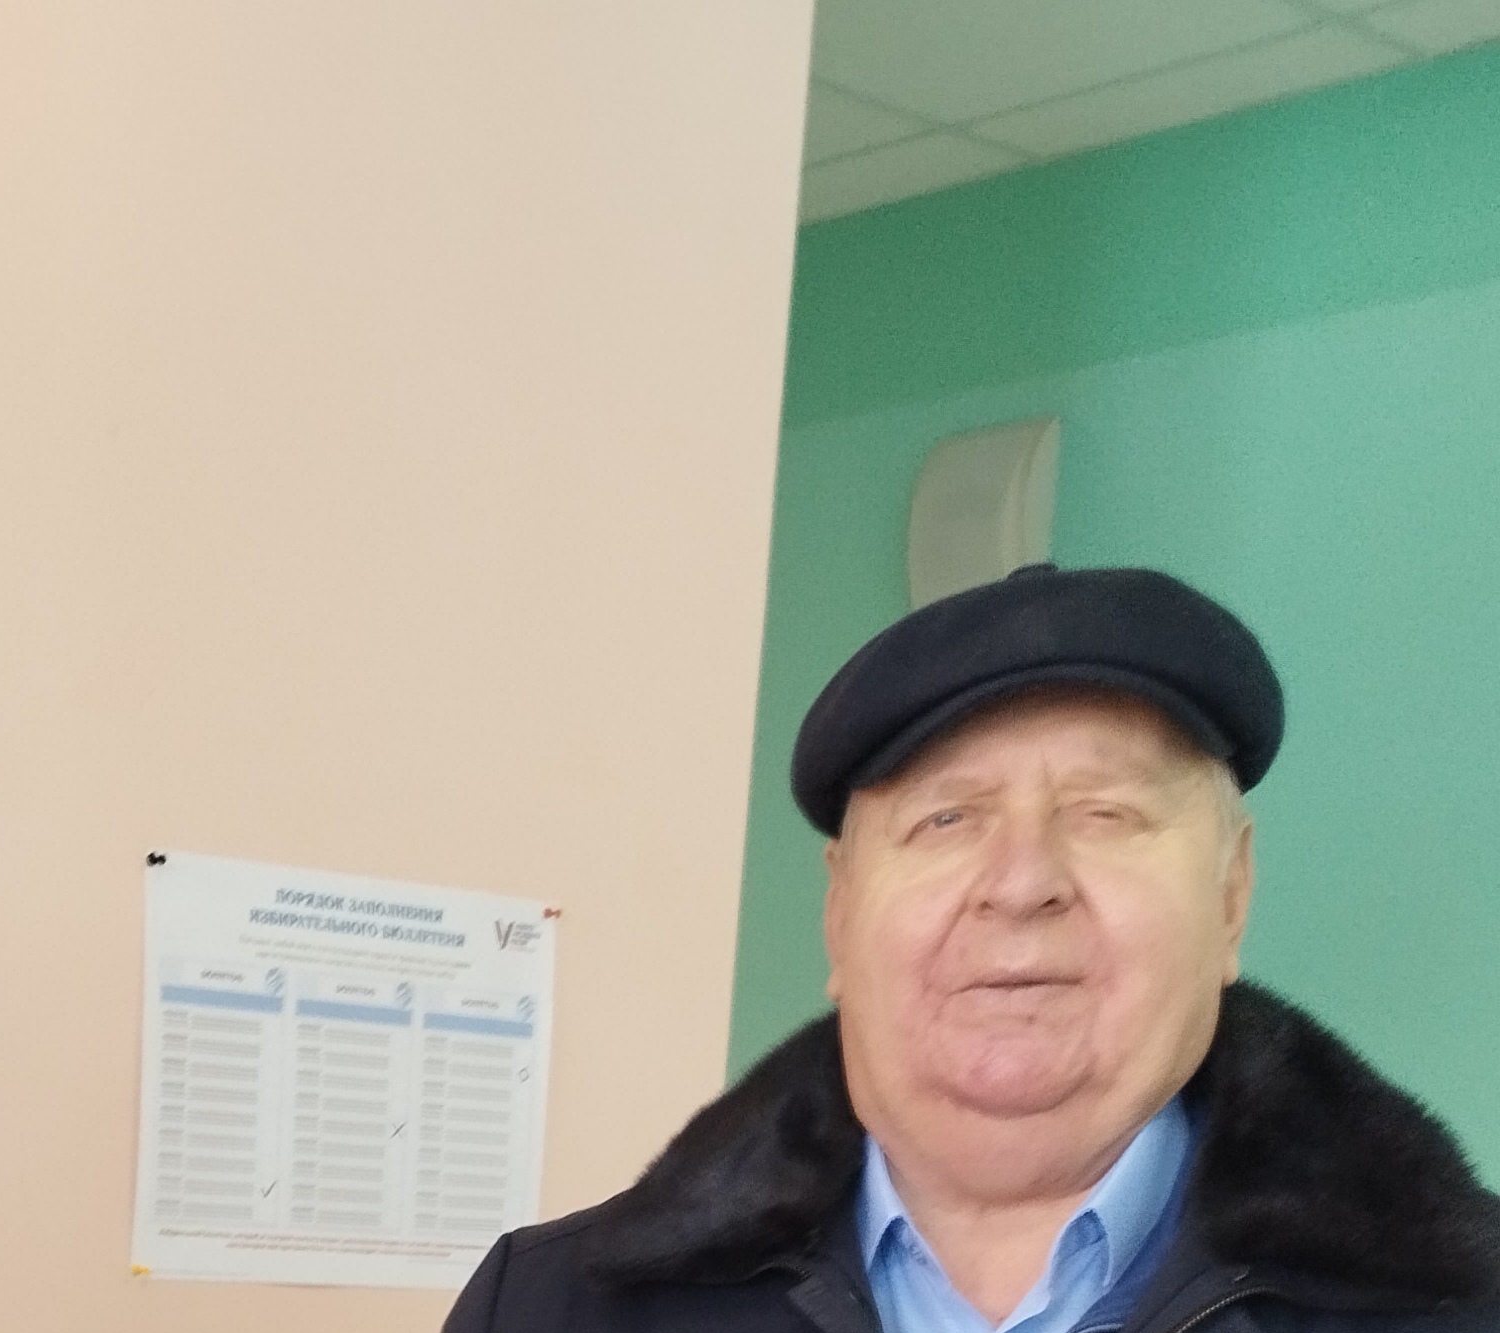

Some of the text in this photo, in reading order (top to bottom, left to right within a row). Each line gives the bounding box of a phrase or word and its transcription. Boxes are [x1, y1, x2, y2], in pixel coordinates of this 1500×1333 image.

[275, 888, 444, 924] ПОРЯДОК ЗАПОЛНЕНИЯ
[249, 908, 467, 948] ИЗБИРАТЕЛЬНОГО БЮЛЛЕТЕНЯ
